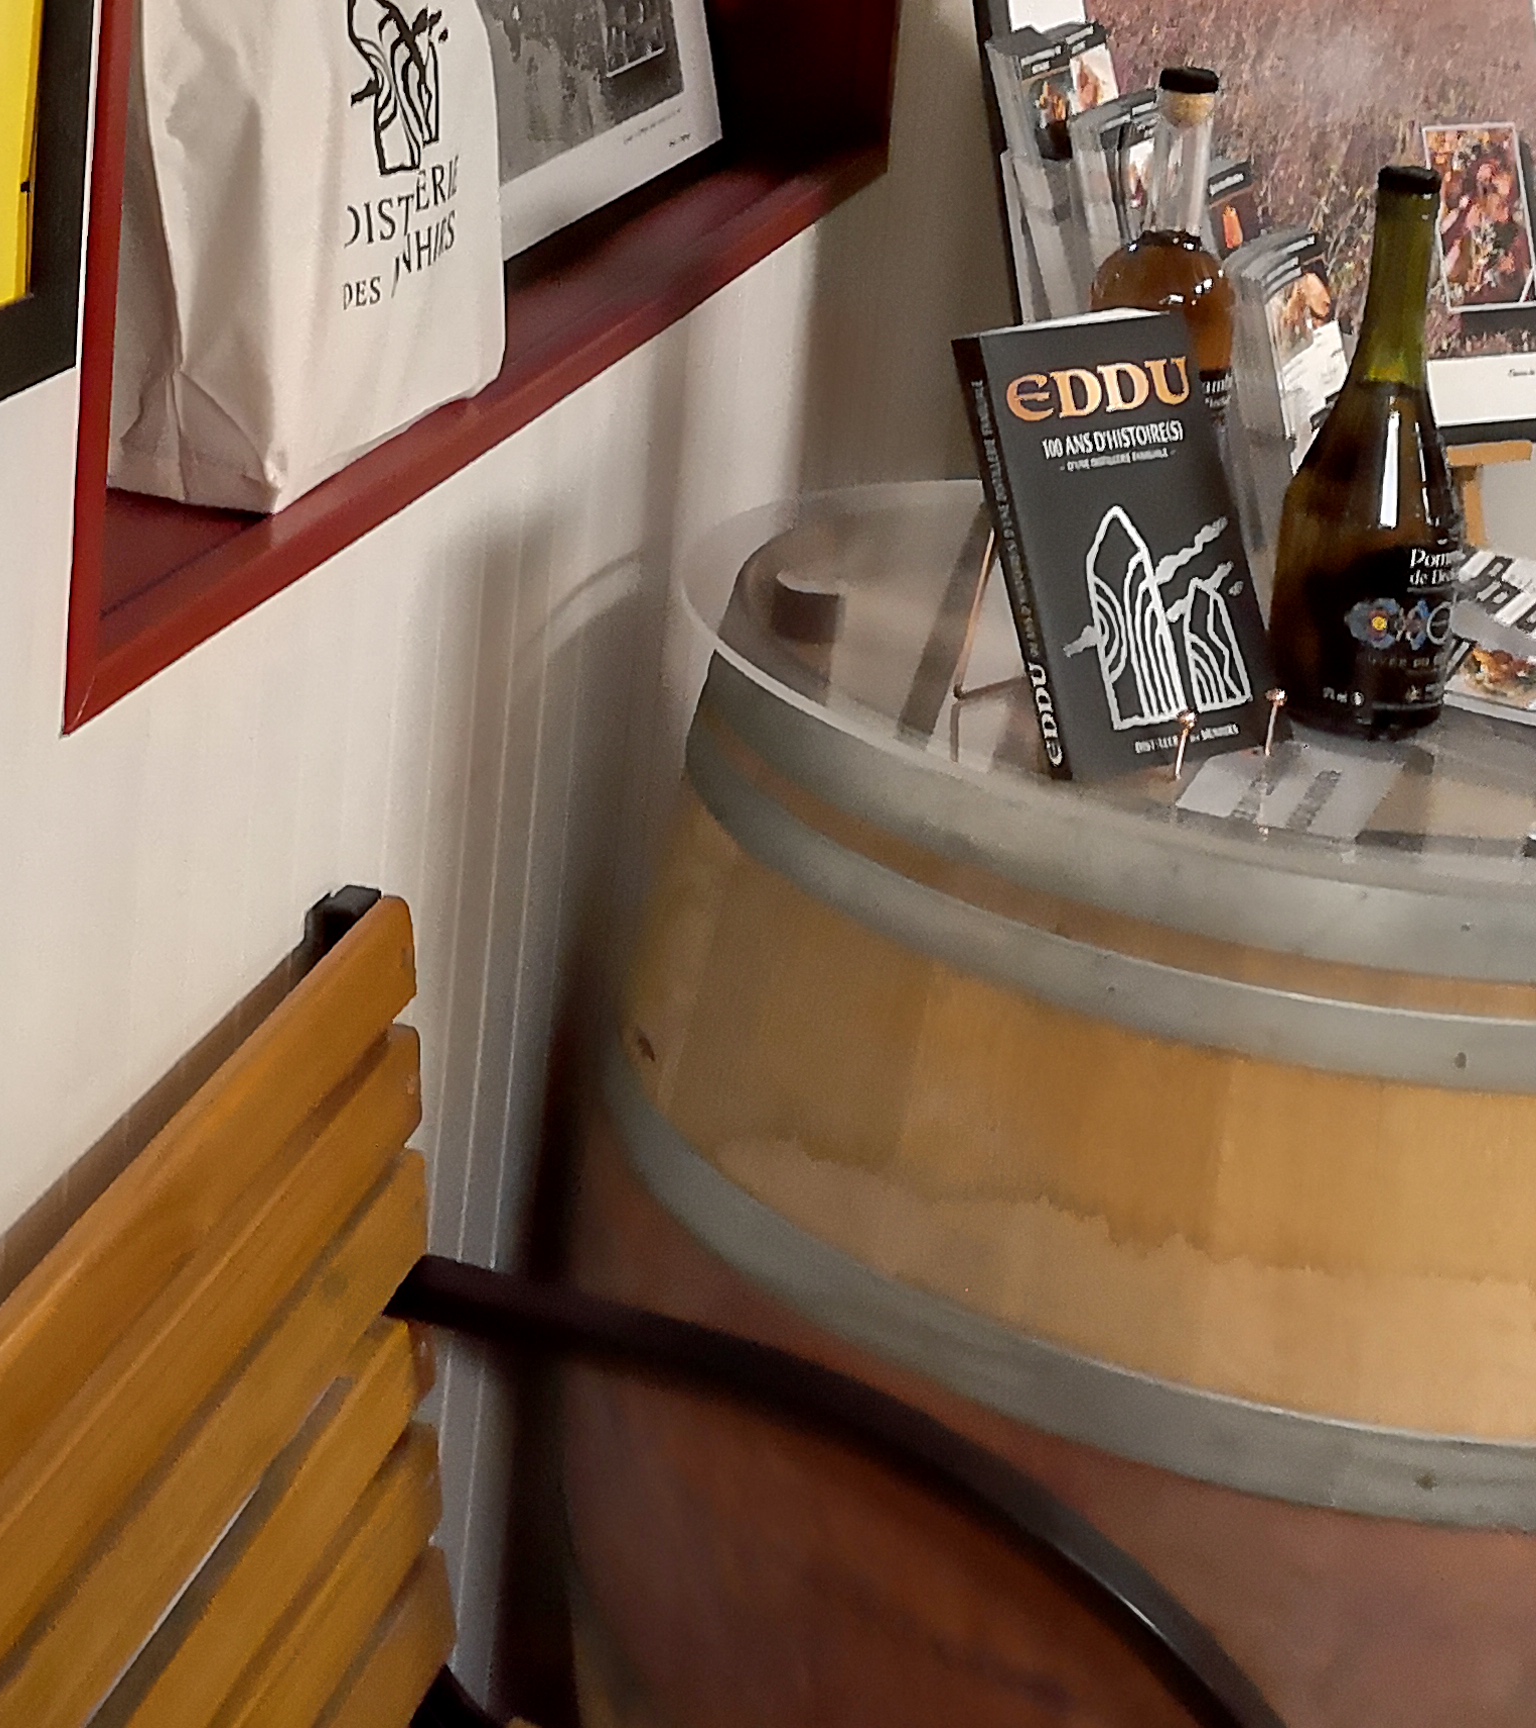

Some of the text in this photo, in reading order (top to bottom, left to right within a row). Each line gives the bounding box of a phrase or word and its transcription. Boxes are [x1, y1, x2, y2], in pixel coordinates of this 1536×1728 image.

[343, 276, 381, 310] DES
[1006, 356, 1190, 421] EDDU
[1042, 437, 1063, 459] 100
[1065, 432, 1093, 455] ANS
[1093, 420, 1184, 452] D'HISTOIRE(S)
[1028, 662, 1063, 766] EDDU
